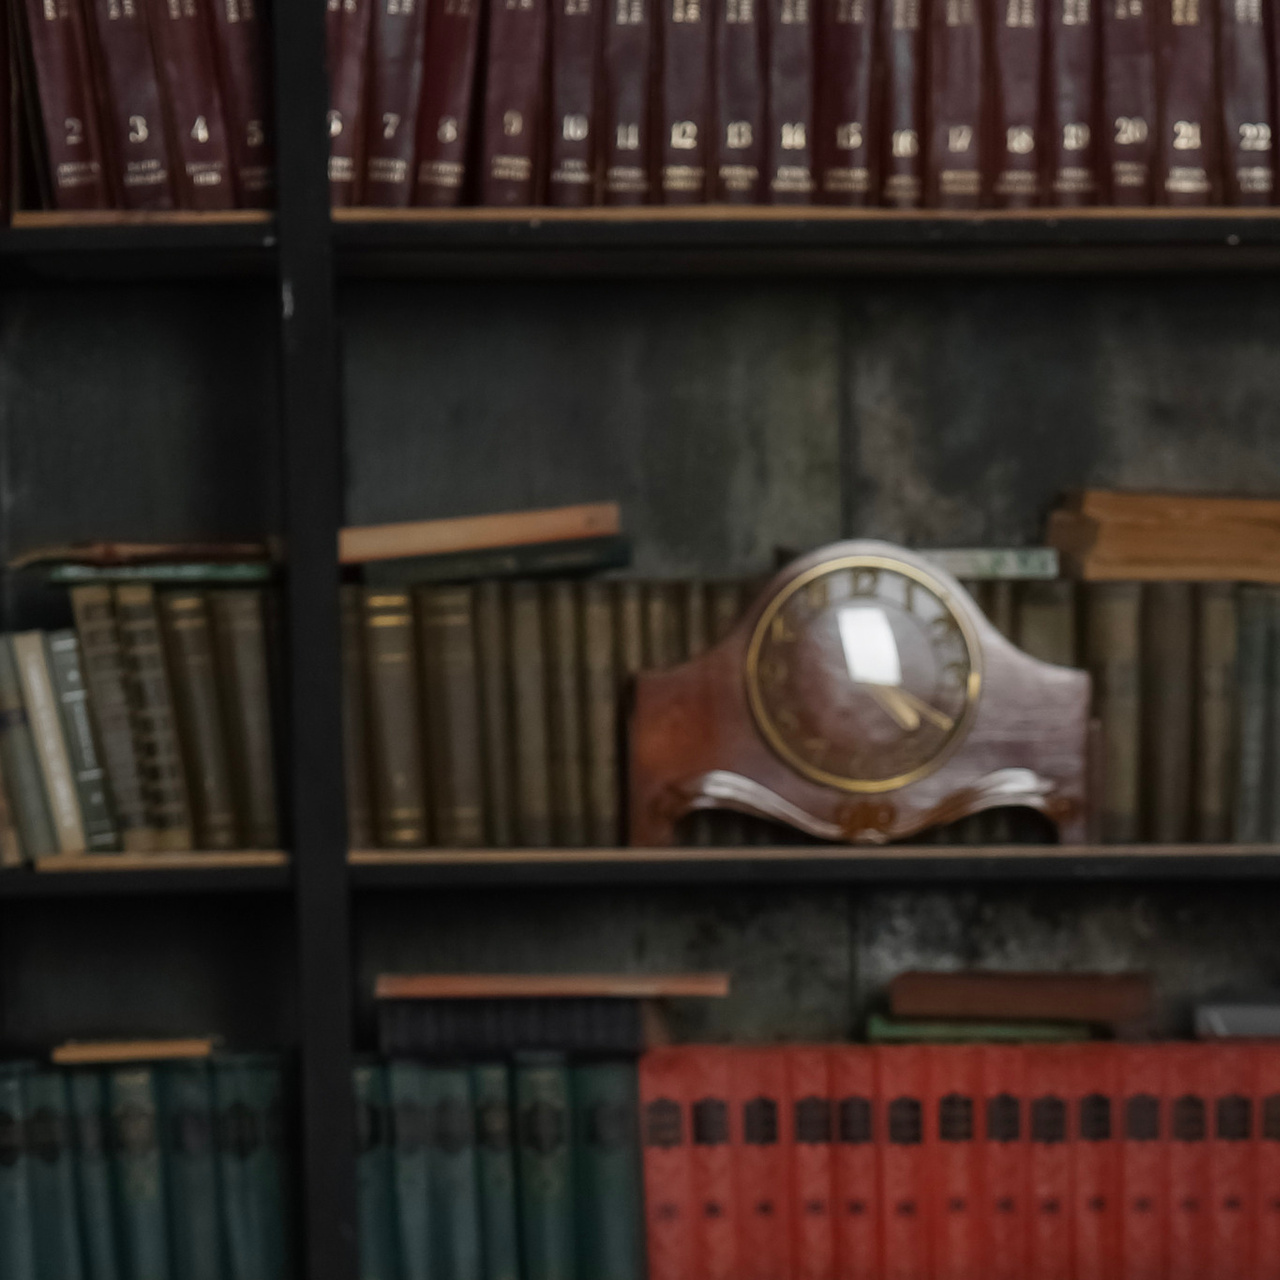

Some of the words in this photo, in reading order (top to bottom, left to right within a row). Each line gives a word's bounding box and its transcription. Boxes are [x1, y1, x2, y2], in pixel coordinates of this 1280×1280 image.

[128, 115, 149, 143] 3
[190, 115, 209, 143] 4
[382, 112, 400, 139] 7
[503, 109, 523, 137] 9
[562, 113, 589, 141] 10
[617, 123, 639, 149] 11
[670, 120, 698, 149] 12
[1114, 116, 1148, 145] 20
[1173, 120, 1201, 150] 21
[1239, 122, 1272, 150] 22
[948, 124, 973, 153] 17
[852, 567, 880, 598] 12
